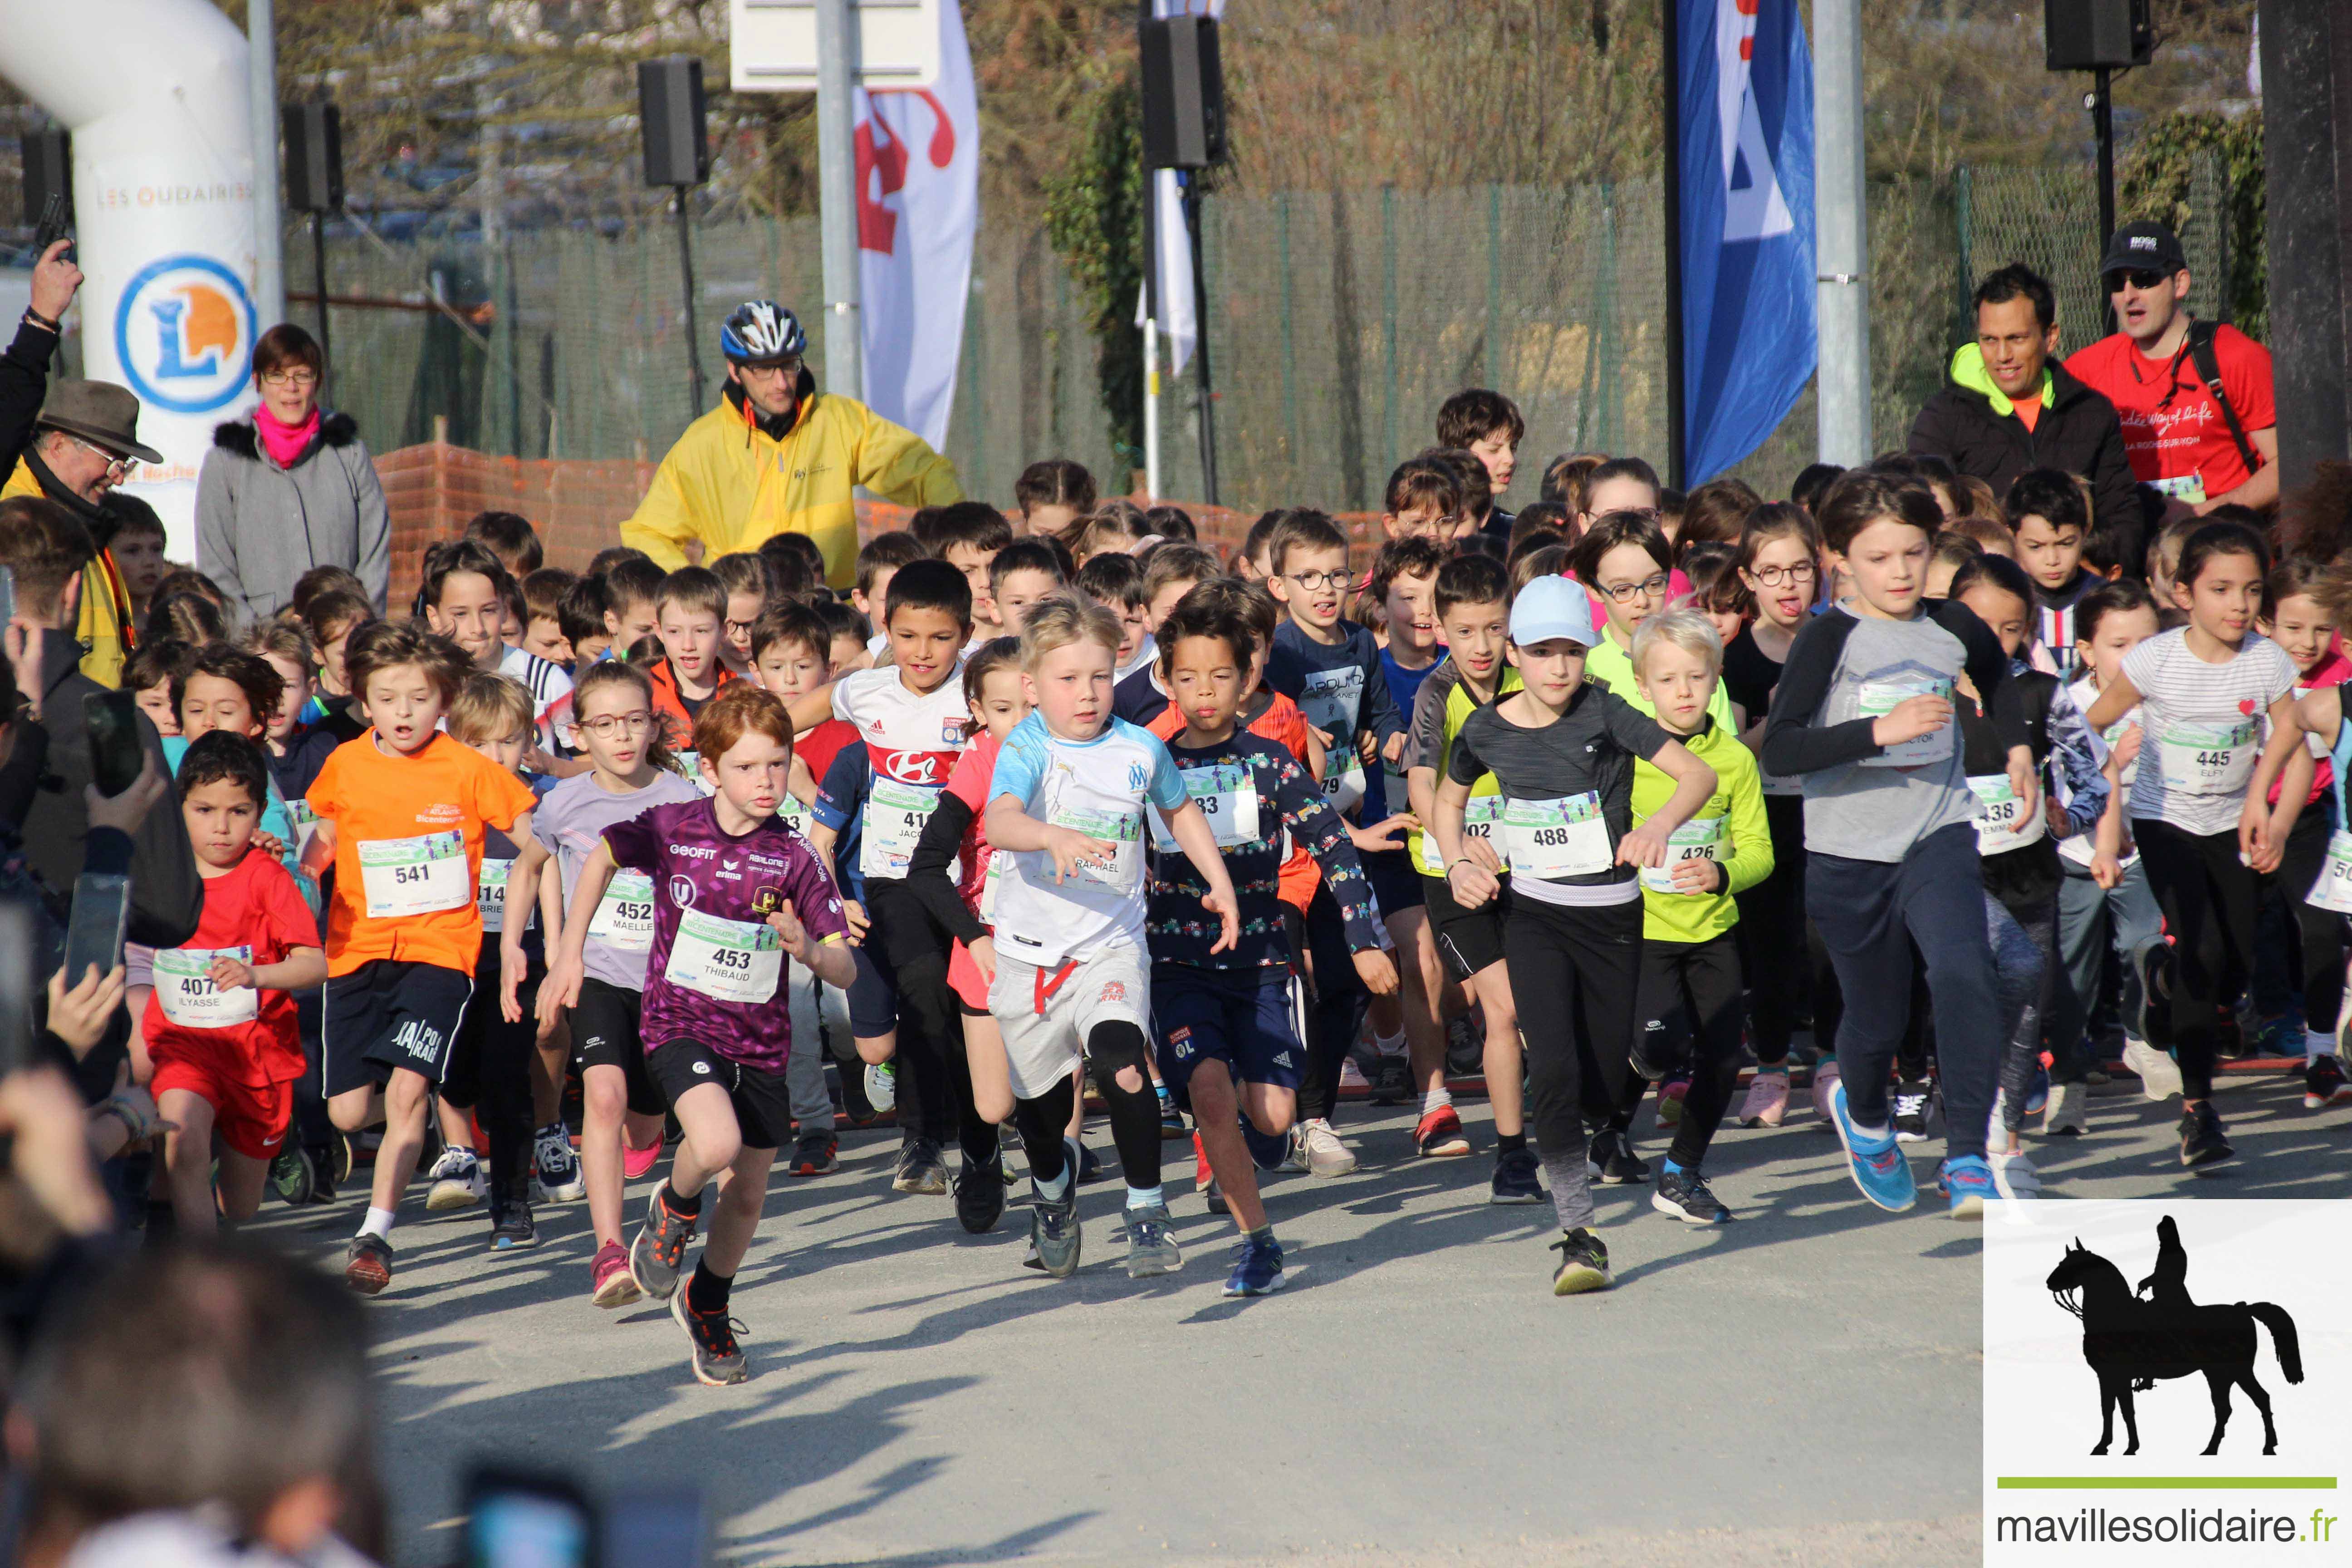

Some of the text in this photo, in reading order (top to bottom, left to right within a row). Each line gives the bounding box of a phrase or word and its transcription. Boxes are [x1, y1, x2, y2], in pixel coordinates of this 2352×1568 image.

[97, 187, 129, 209] LES
[2147, 412, 2172, 436] Way
[2171, 407, 2181, 425] of
[2182, 401, 2214, 426] life
[2197, 751, 2231, 765] 445
[1534, 828, 1568, 846] 488
[395, 864, 429, 884] 541
[715, 870, 741, 881] erima
[616, 902, 651, 920] 452
[613, 920, 653, 931] MAELLE
[686, 921, 738, 940] BICENTENAIRE
[712, 949, 751, 969] 453
[705, 965, 750, 981] THIBAUD
[181, 978, 214, 995] 407
[179, 997, 220, 1007] ILYASSE
[1273, 1057, 1293, 1068] adidas
